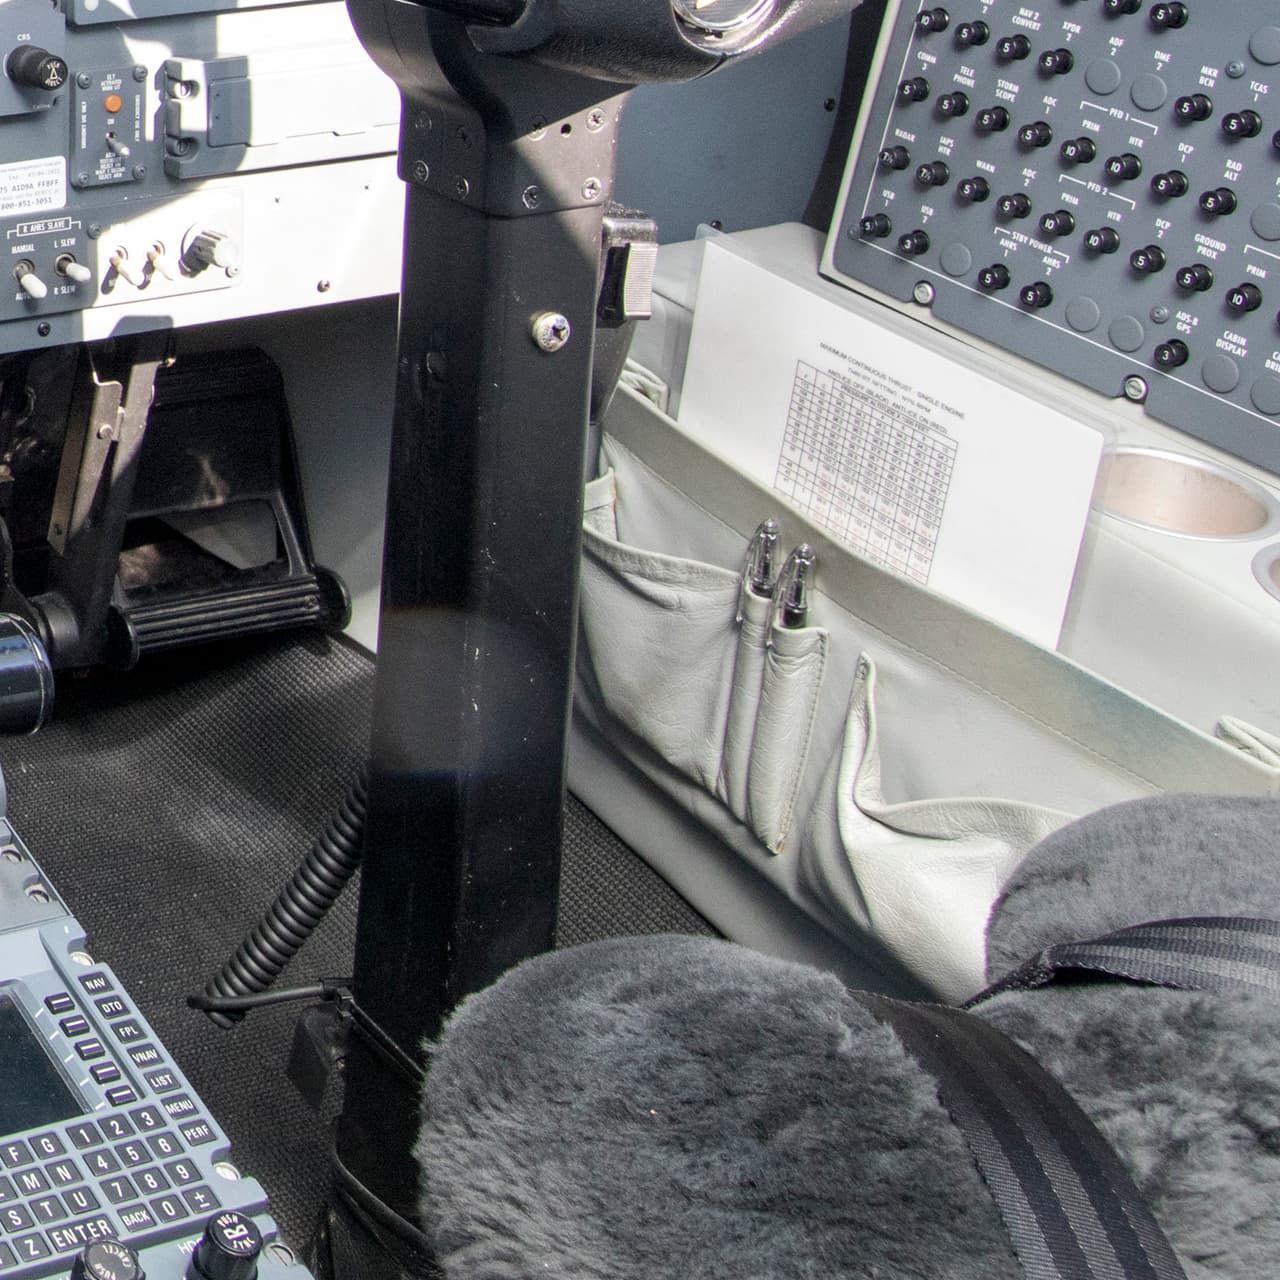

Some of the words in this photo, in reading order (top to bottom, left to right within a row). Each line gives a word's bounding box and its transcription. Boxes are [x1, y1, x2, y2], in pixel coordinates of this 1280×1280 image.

[1194, 233, 1227, 252] GROUND
[1216, 340, 1248, 358] DISPLAY
[166, 1100, 193, 1117] MENU
[122, 1210, 149, 1226] BACK
[52, 1222, 112, 1252] ENTER
